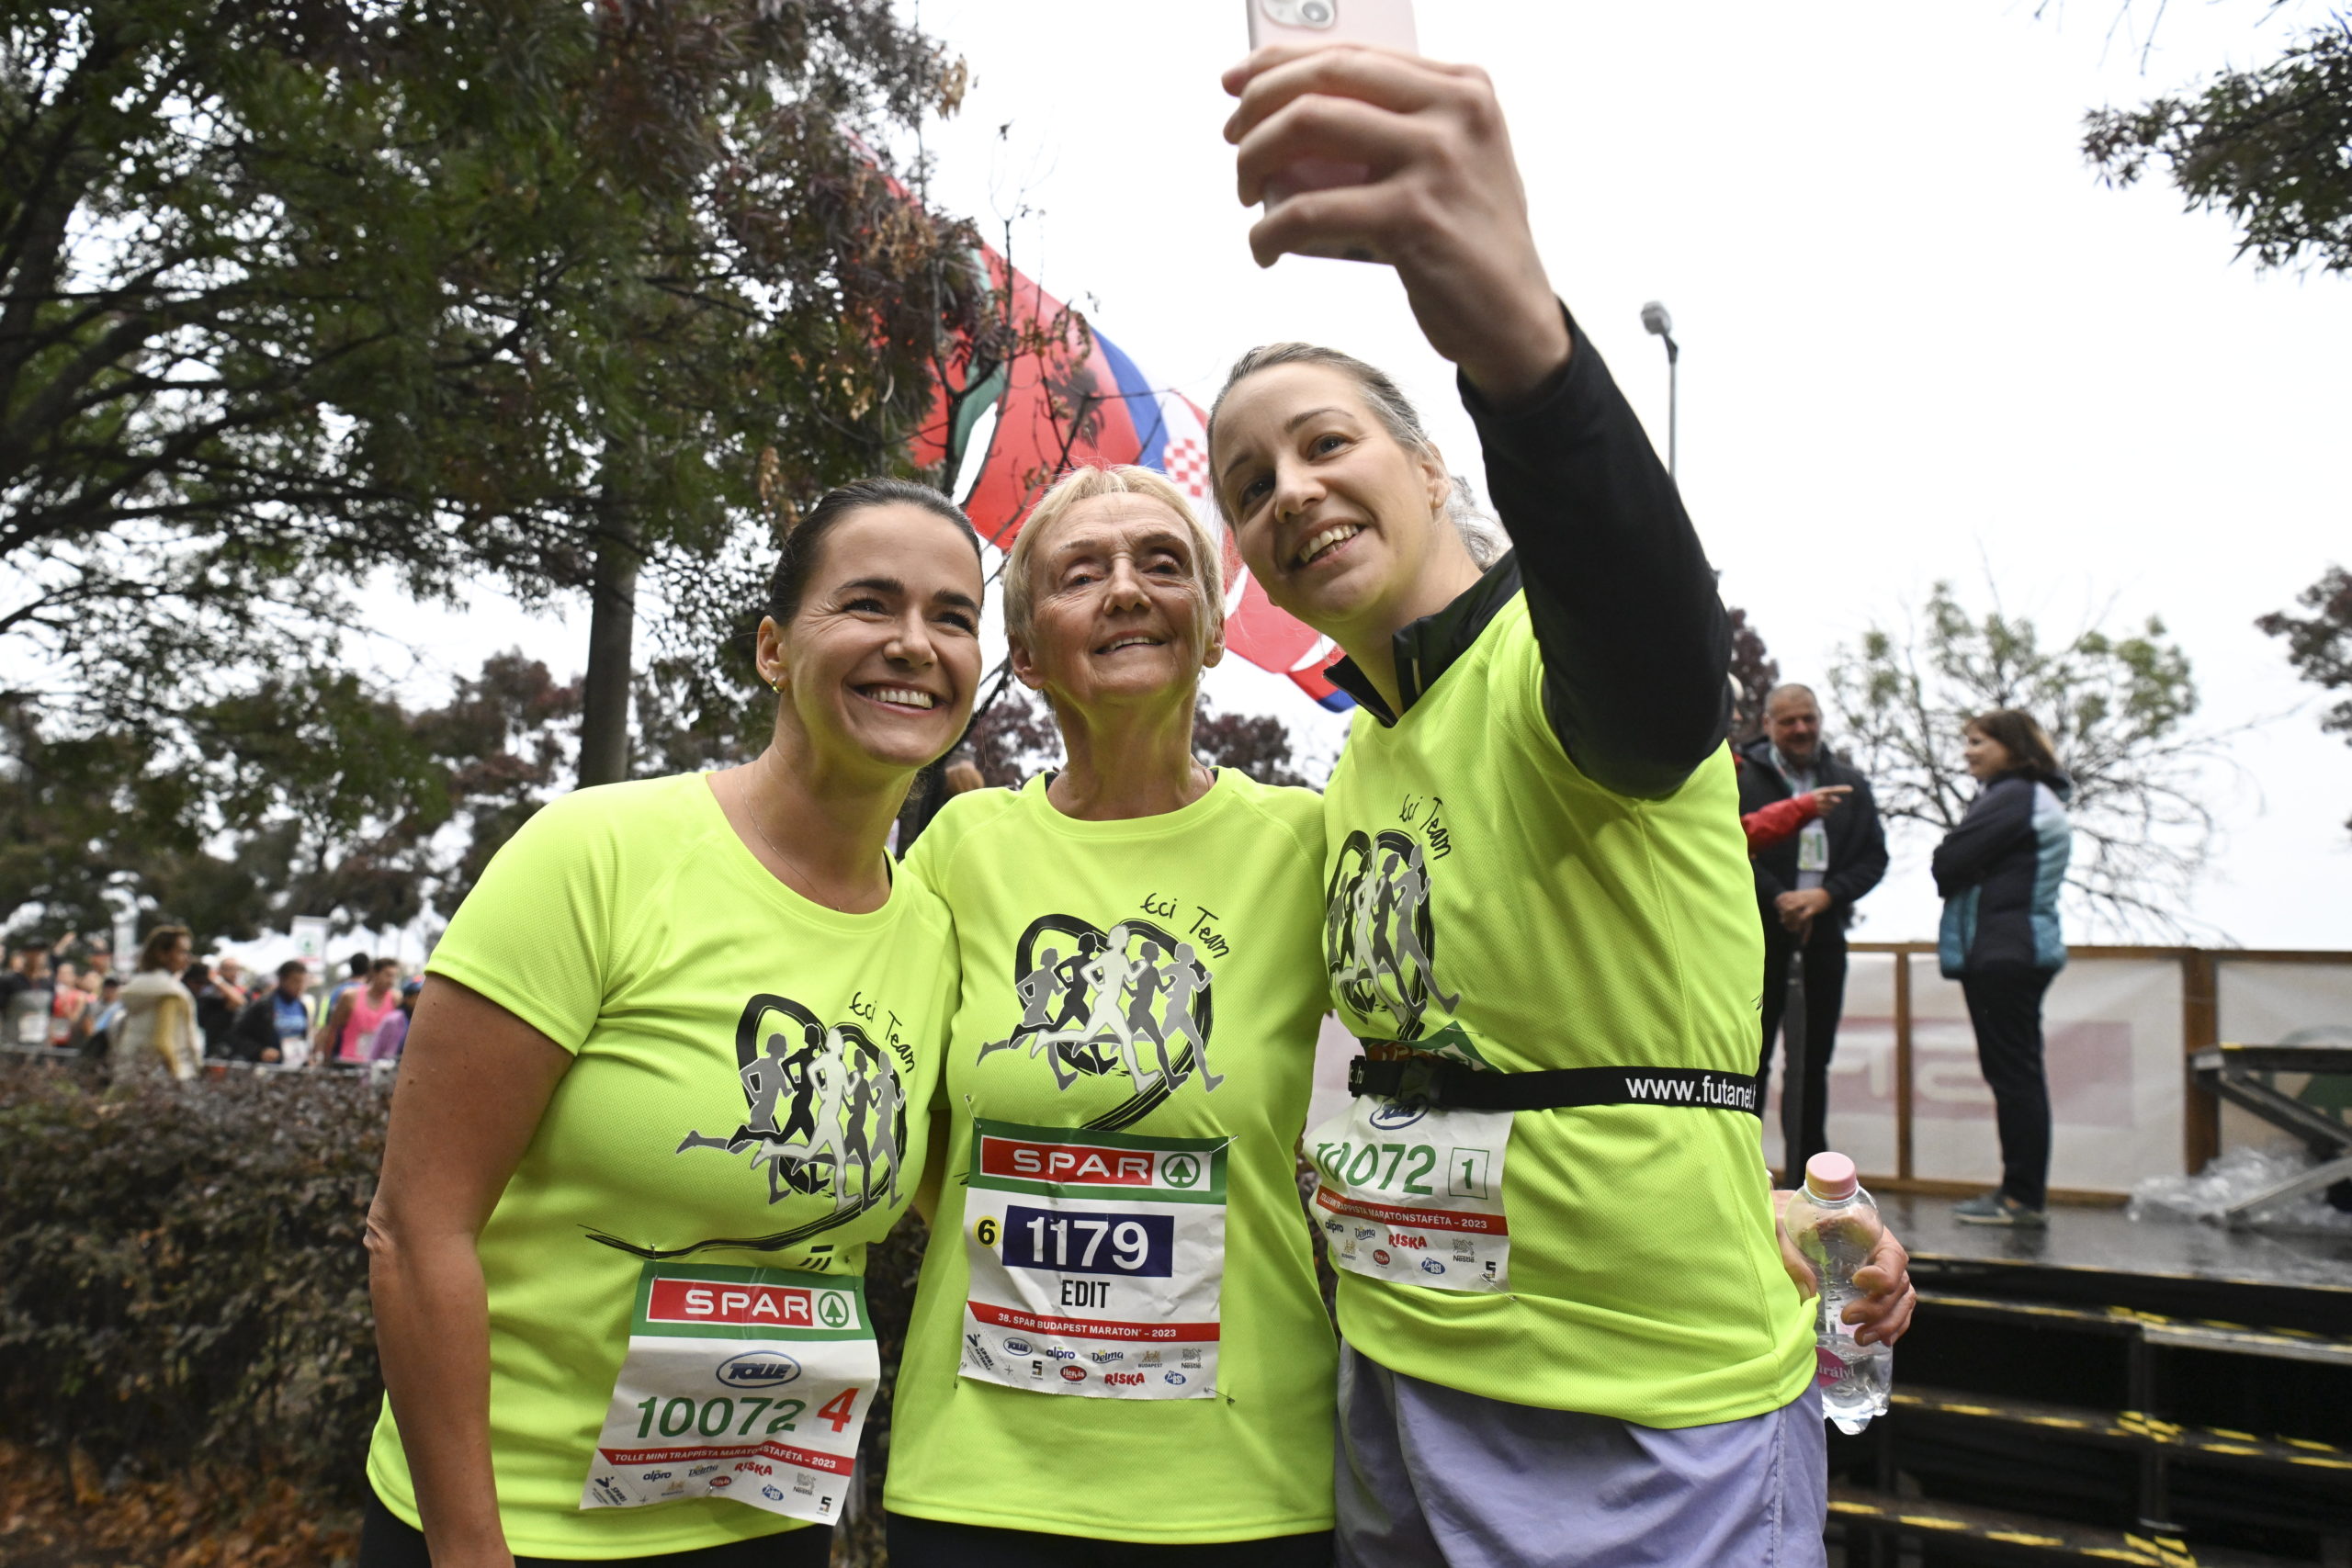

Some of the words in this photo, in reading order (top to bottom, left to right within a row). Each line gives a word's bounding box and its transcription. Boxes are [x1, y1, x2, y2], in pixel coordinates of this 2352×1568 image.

[1419, 796, 1451, 860] Team
[1140, 893, 1177, 919] Eci
[1189, 906, 1229, 958] Team
[849, 991, 877, 1023] Eci
[885, 1010, 915, 1073] Team
[1013, 1148, 1148, 1179] SPAR
[1462, 1158, 1474, 1190] 1
[978, 1219, 996, 1245] 6
[1462, 1219, 1487, 1228] 2023
[1026, 1216, 1148, 1269] 1179
[1388, 1234, 1427, 1249] RISKA
[684, 1290, 808, 1320] SPAR
[1061, 1279, 1110, 1308] EDIT
[998, 1313, 1011, 1323] 38.
[1012, 1316, 1035, 1326] SPAR
[1037, 1322, 1087, 1333] BUDAPEST
[1151, 1329, 1176, 1337] 2023
[1046, 1347, 1075, 1360] alpro
[1091, 1351, 1124, 1363] Delma
[1104, 1372, 1145, 1386] RISKA
[637, 1396, 807, 1438] 10072
[817, 1388, 860, 1433] 4
[646, 1452, 667, 1461] MINI
[671, 1450, 718, 1459] TRAPPISTA
[811, 1457, 836, 1468] 2023
[735, 1461, 773, 1476] RISKA
[643, 1471, 672, 1482] alpro
